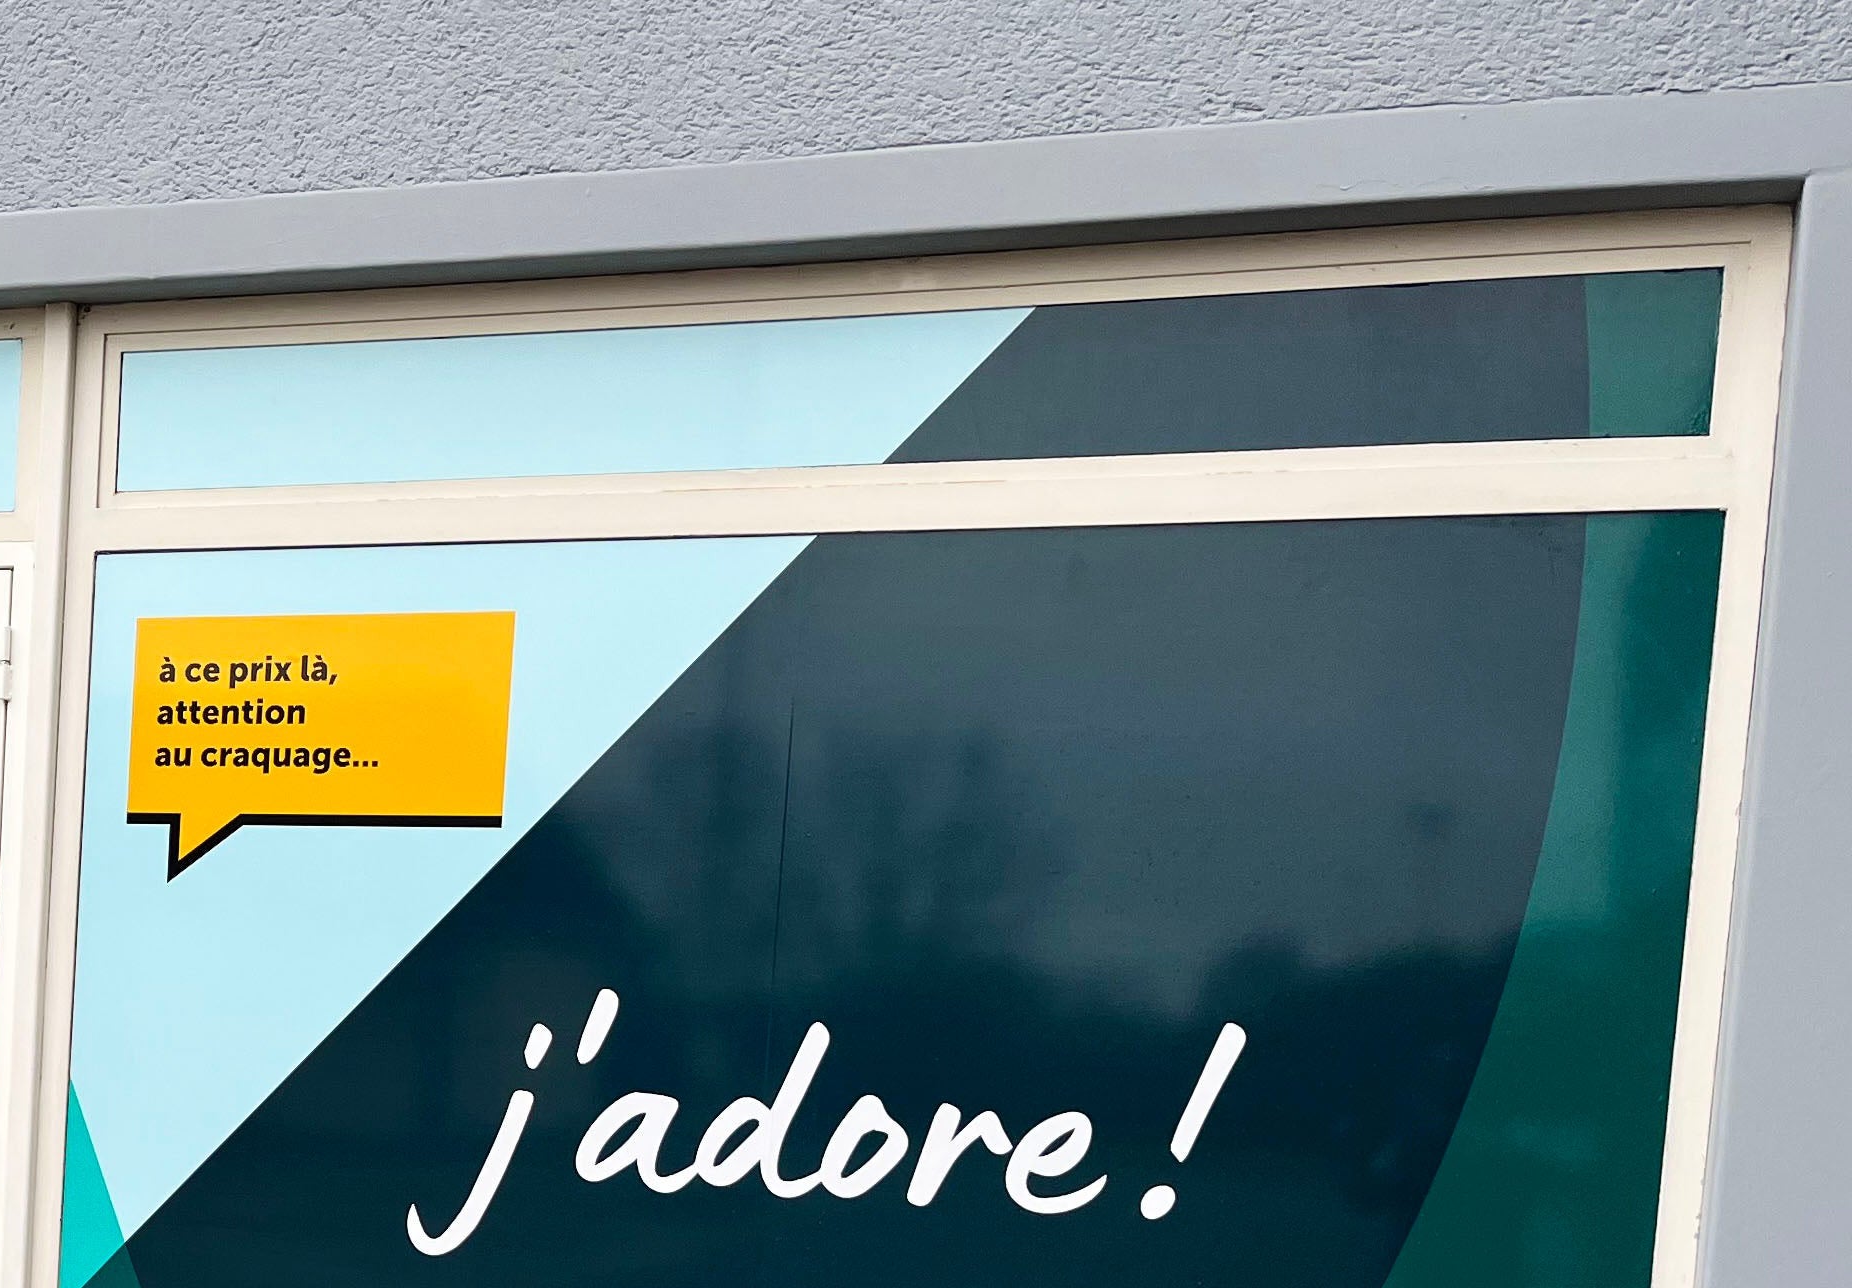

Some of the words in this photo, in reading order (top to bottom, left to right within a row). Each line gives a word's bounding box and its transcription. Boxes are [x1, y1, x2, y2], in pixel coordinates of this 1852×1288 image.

[159, 656, 176, 683] à
[185, 662, 220, 683] ce
[229, 655, 292, 689] prix
[300, 654, 338, 686] là,
[156, 698, 306, 725] attention
[154, 747, 192, 767] au
[406, 988, 1108, 1256] j'adore
[1140, 1022, 1247, 1220] !
